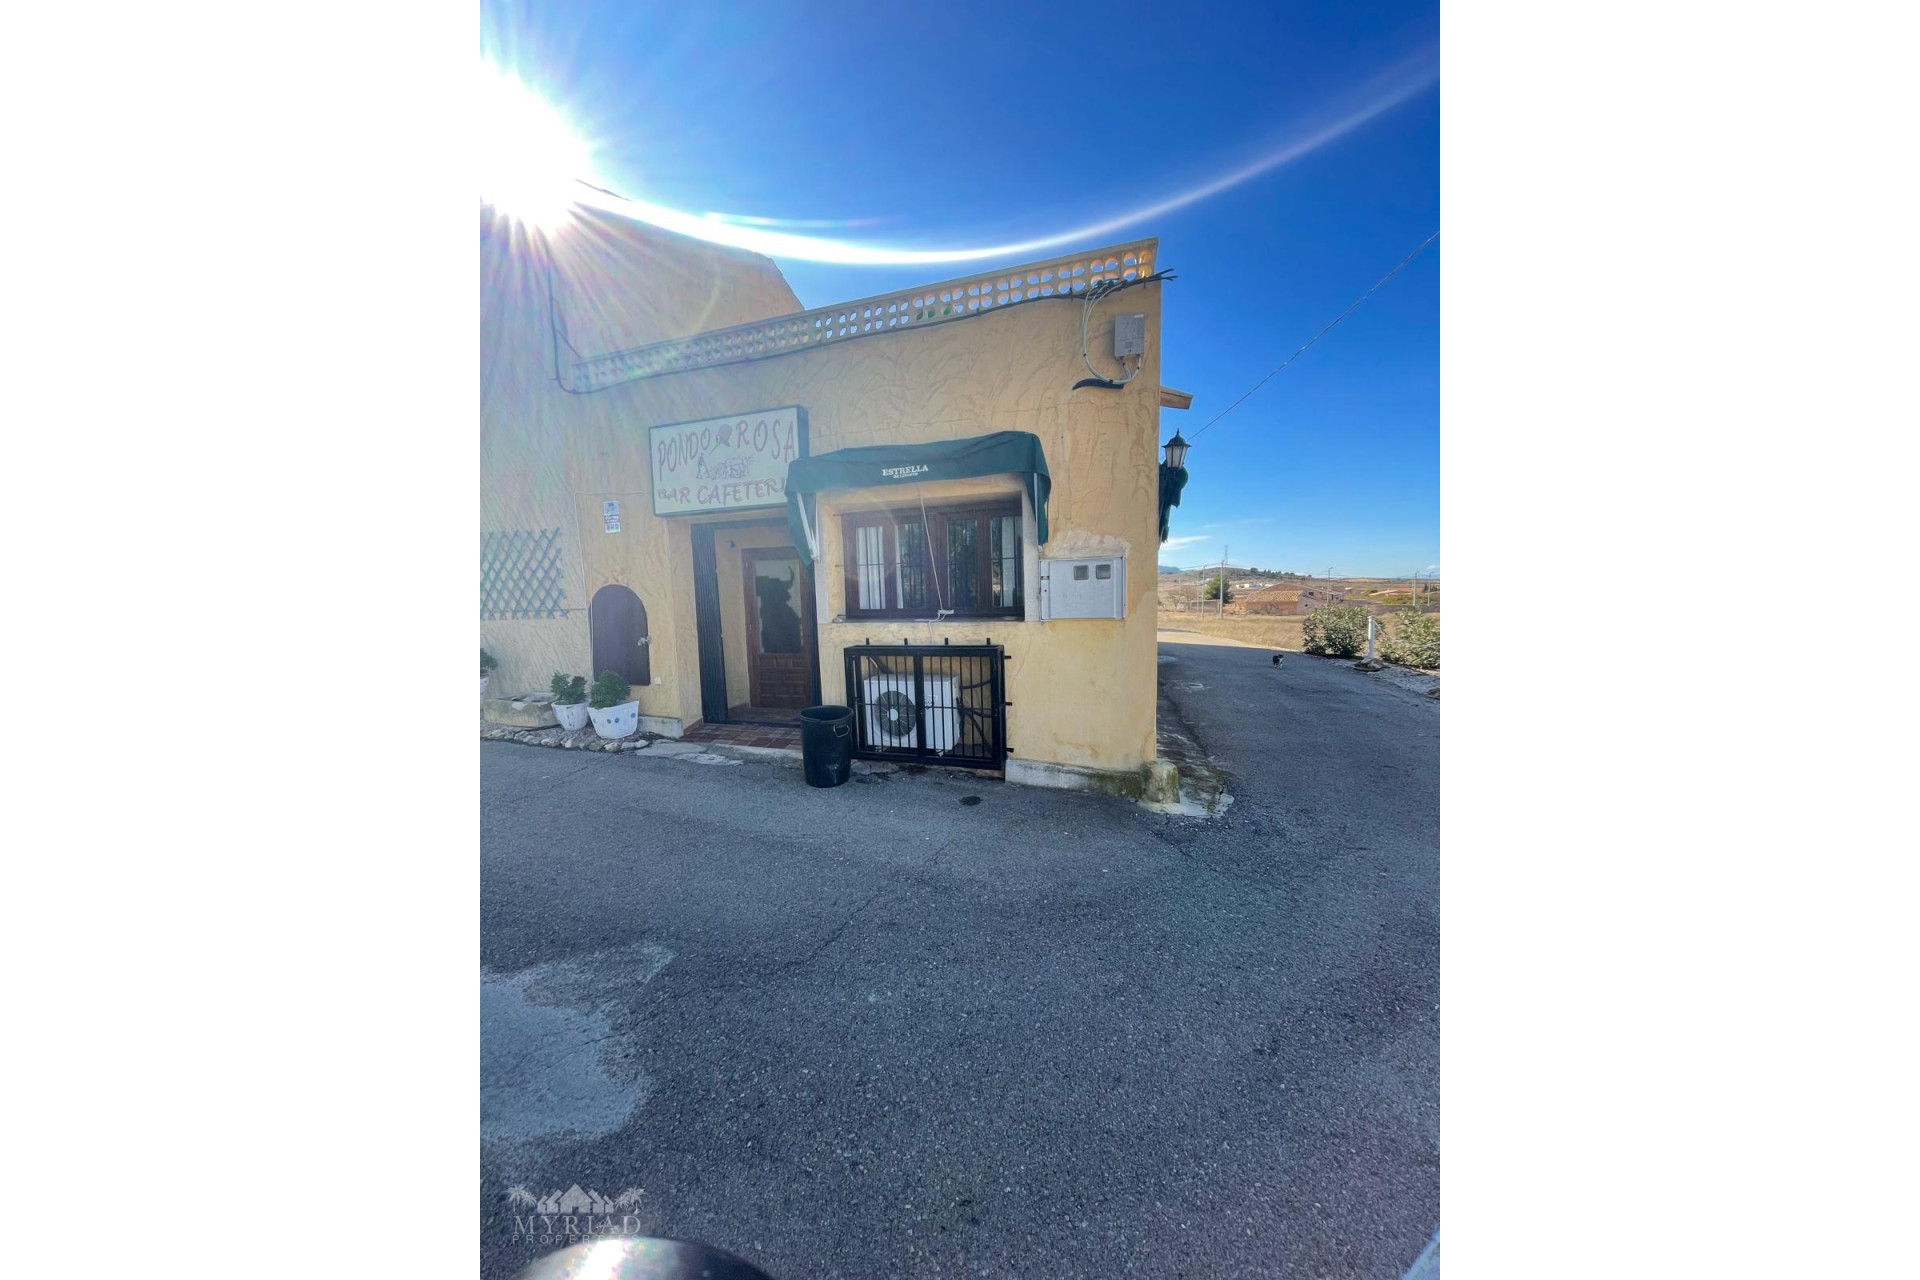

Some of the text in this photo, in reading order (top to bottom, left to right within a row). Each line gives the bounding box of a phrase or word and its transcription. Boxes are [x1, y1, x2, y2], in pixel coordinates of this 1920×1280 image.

[657, 420, 796, 482] PONDO ROSA
[881, 464, 929, 477] ESTRELLA
[658, 477, 785, 506] BAR CAFETERI
